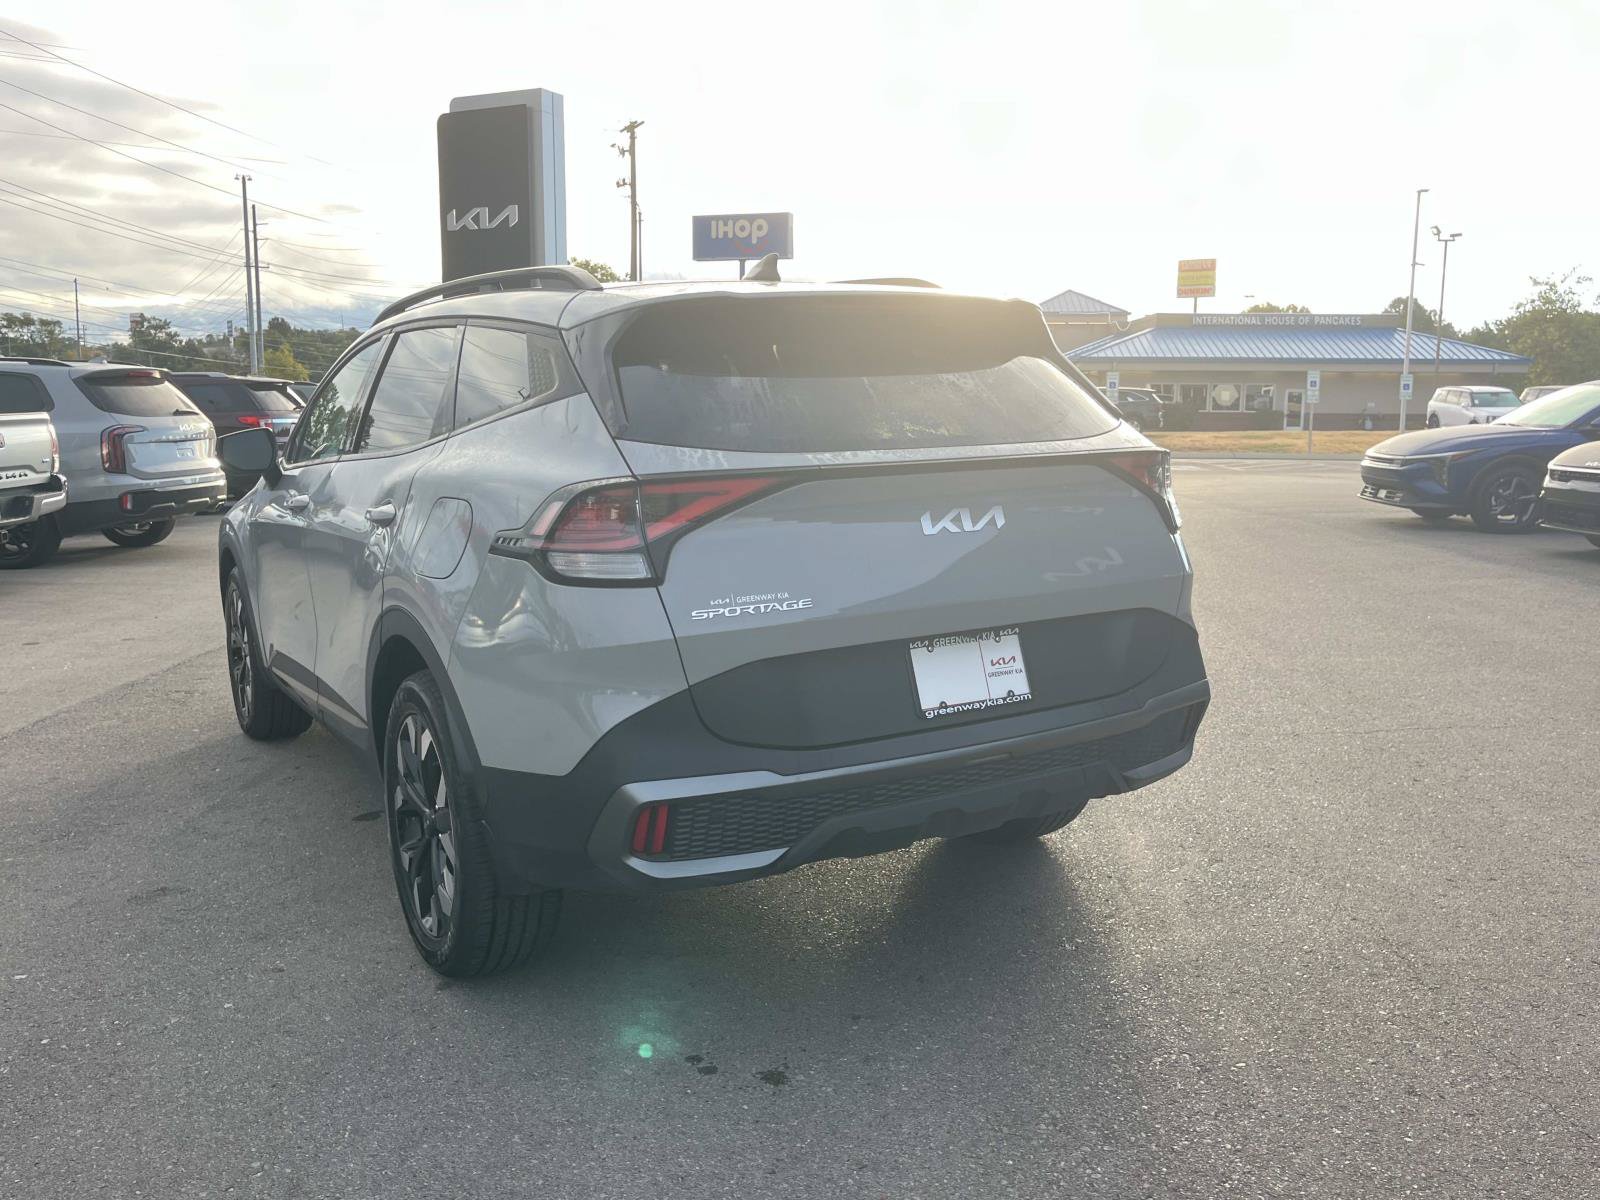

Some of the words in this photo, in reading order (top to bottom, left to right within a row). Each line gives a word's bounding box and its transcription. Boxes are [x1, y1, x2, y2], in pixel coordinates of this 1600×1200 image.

[446, 204, 519, 231] KIA
[1192, 315, 1262, 326] INTERNATIONAL
[1264, 315, 1296, 326] HOUSE
[1299, 315, 1311, 325] OF
[1314, 315, 1362, 326] PANCAKES
[920, 505, 1006, 536] KIA
[710, 598, 730, 606] KIA
[736, 594, 776, 604] GREENWAY
[777, 592, 790, 600] KIA
[691, 598, 814, 620] SPORTAGE
[990, 655, 1017, 667] KIA
[987, 669, 1014, 677] GREENWAY
[925, 693, 1032, 718] greenwaykia.com
